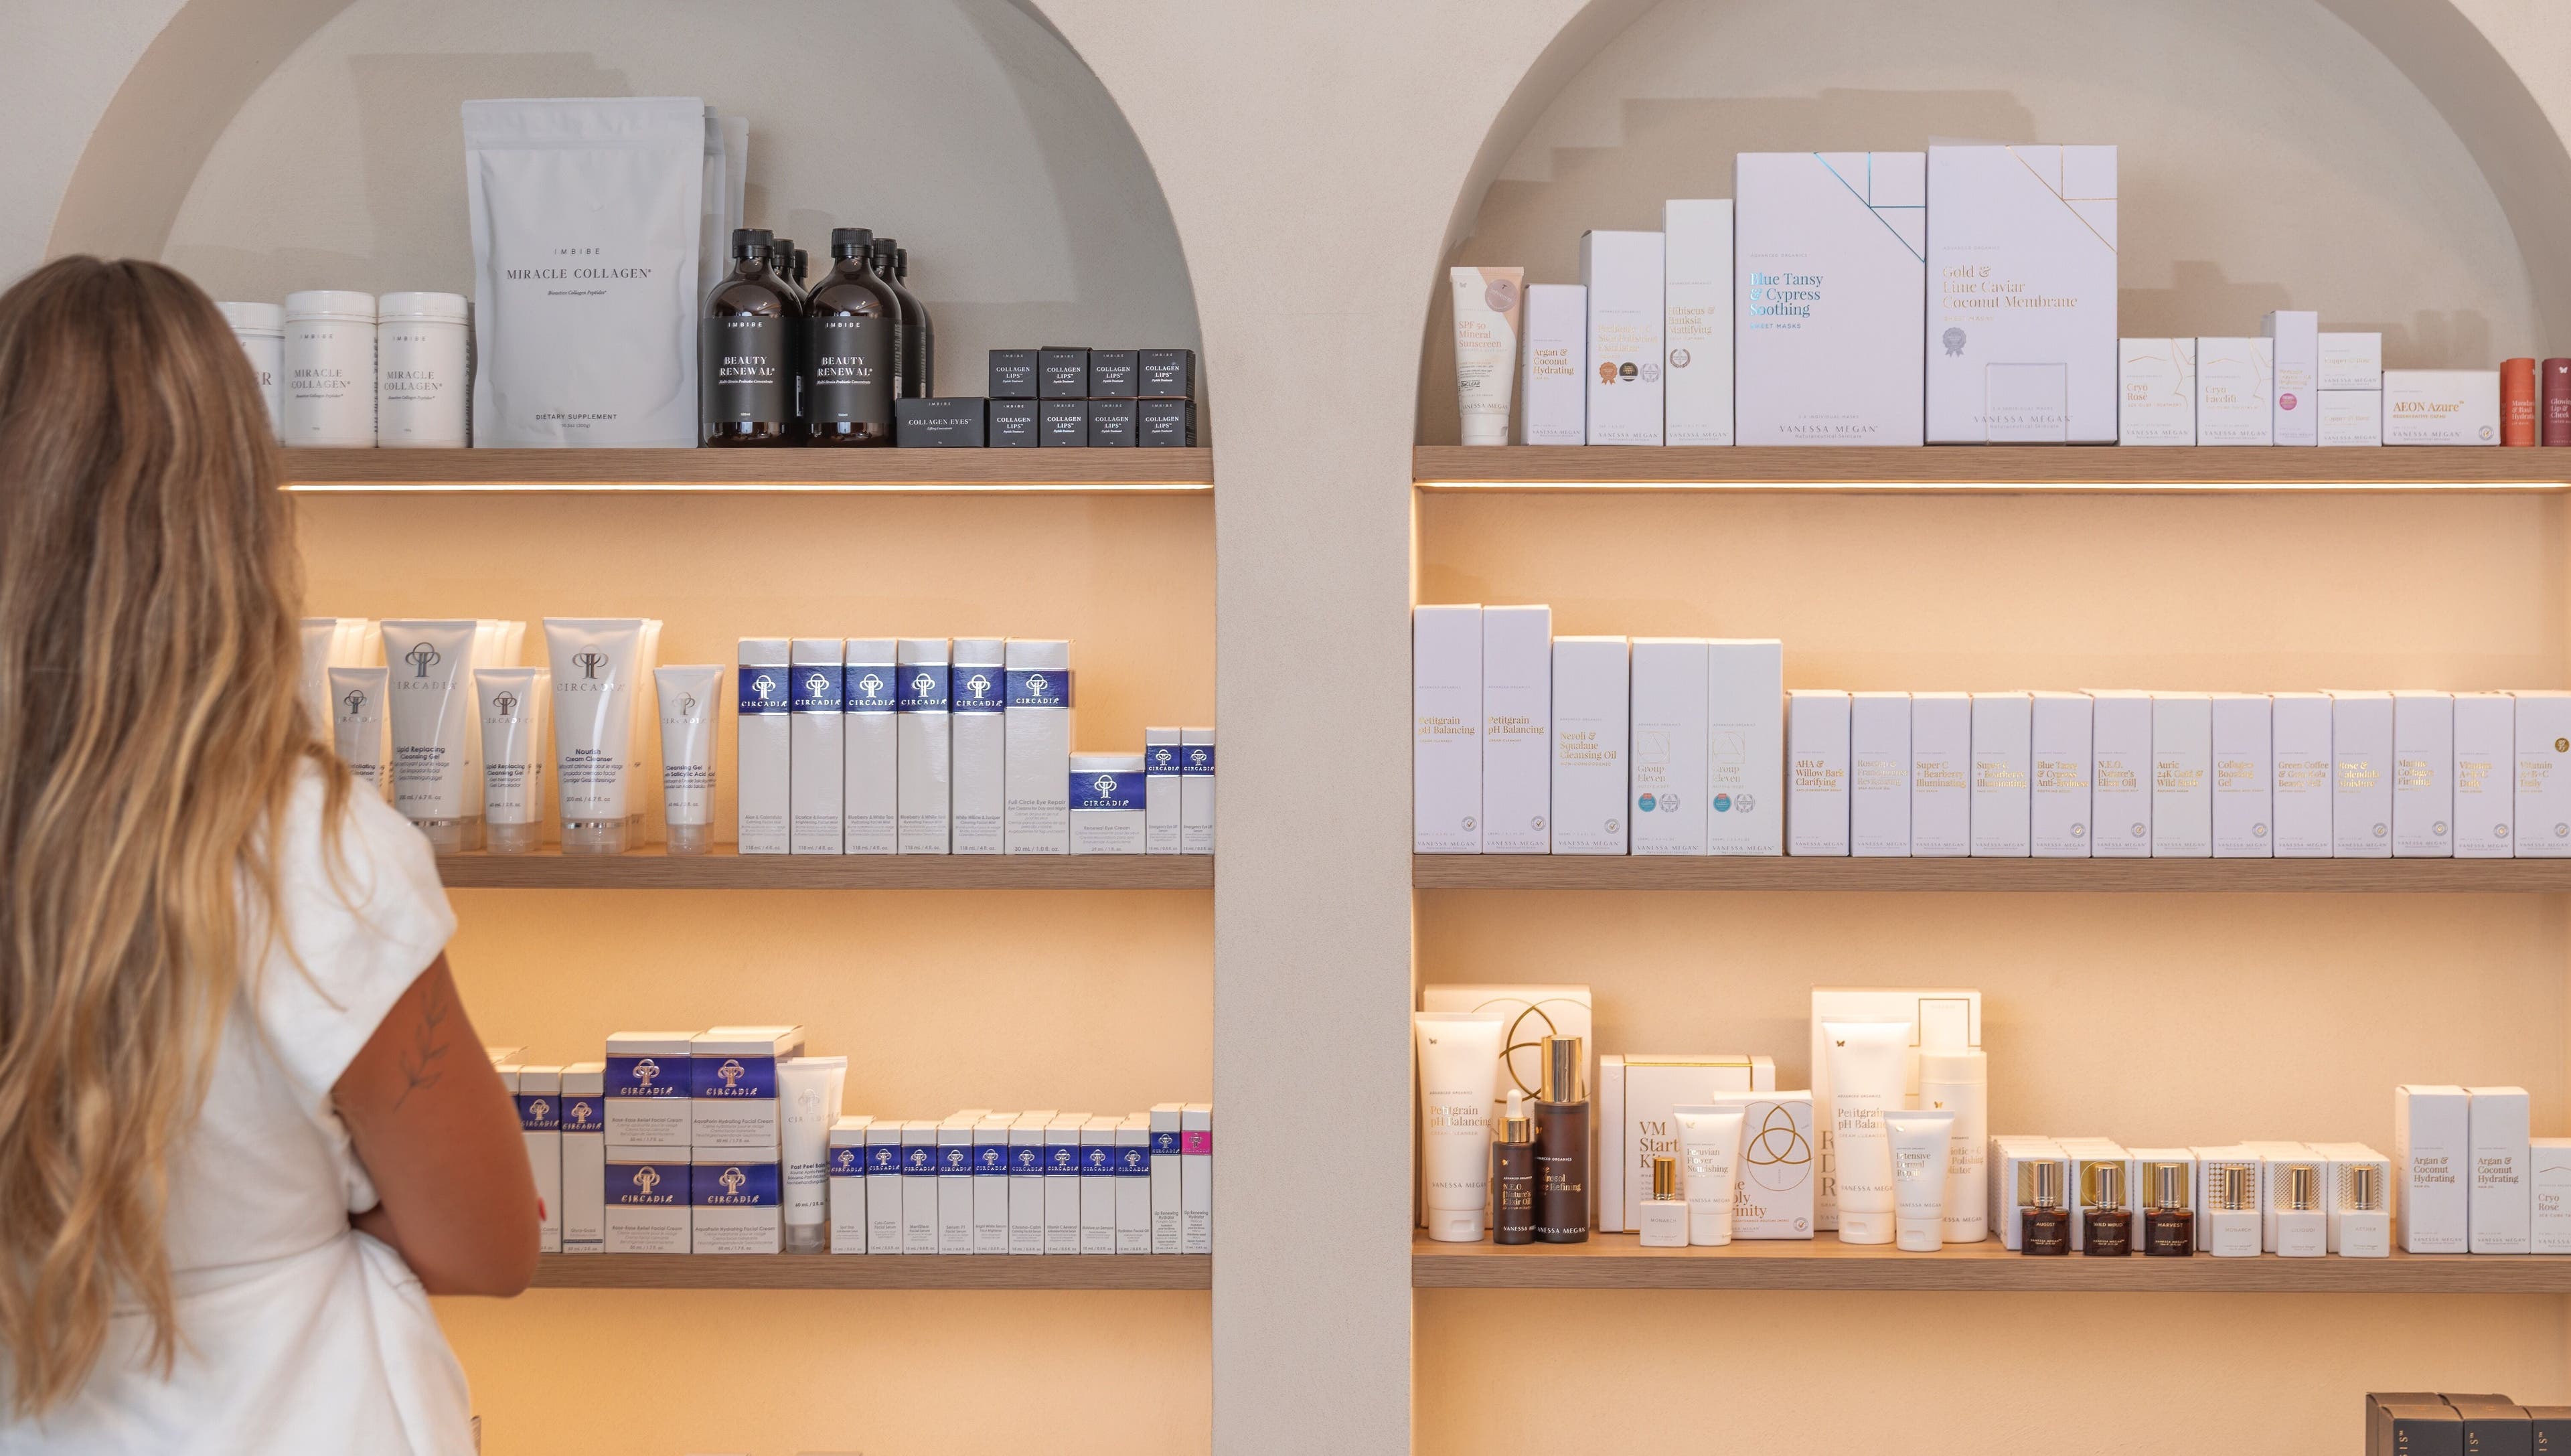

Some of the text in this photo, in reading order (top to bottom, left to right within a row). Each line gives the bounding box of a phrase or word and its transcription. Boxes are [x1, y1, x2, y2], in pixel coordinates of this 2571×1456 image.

[507, 270, 567, 279] MIRACLE
[1943, 266, 1991, 277] Gold &
[1750, 272, 1824, 288] Blue Tansy
[1944, 281, 2025, 293] Lime Caviar
[1750, 288, 1820, 303] & Cypress
[1943, 297, 2078, 308] Coconut Membrane
[1668, 307, 1705, 315] Hibiscus
[1749, 303, 1810, 318] Soothing
[1668, 325, 1712, 335] Mattifying
[1460, 331, 1491, 339] Mineral
[1460, 340, 1501, 348] Sunscreen
[1533, 348, 1558, 357] Argan
[724, 356, 767, 365] BEAUTY
[822, 357, 864, 366] BEAUTY
[294, 370, 342, 378] MIRACLE
[1533, 366, 1574, 375] Hydrating
[2126, 384, 2148, 393] Cryo
[2393, 402, 2424, 412] AEON
[1974, 415, 2024, 423] VANESSA
[1419, 716, 1460, 726] Petitgrain
[1488, 716, 1529, 726] Petitgrain
[1419, 725, 1475, 735] pH Balancing
[1488, 724, 1544, 735] pH Balancing
[1560, 732, 1587, 740] Neroli
[1560, 742, 1598, 750] Squalane
[1560, 751, 1616, 760] Cleansing Oil
[1916, 761, 1940, 770] Super
[2305, 761, 2329, 769] Coffee
[2339, 761, 2367, 770] Rose &
[1638, 765, 1664, 775] Group
[1924, 770, 1964, 779] Bearberry
[1796, 778, 1837, 787] Clarifying
[1916, 779, 1966, 788] Illuminating
[1431, 1106, 1478, 1116] Petitgrain
[1431, 1117, 1491, 1127] pH Balancing
[1839, 1121, 1851, 1130] pH
[1640, 1122, 1666, 1135] VM
[1687, 1165, 1729, 1173] Nourishing
[1896, 1161, 1925, 1169] Dermal
[1897, 1169, 1922, 1177] Repair
[2414, 1175, 2455, 1184] Hydrating
[2479, 1175, 2519, 1184] Hydrating
[1550, 1183, 1581, 1192] Refining
[2538, 1194, 2559, 1203] Cryo
